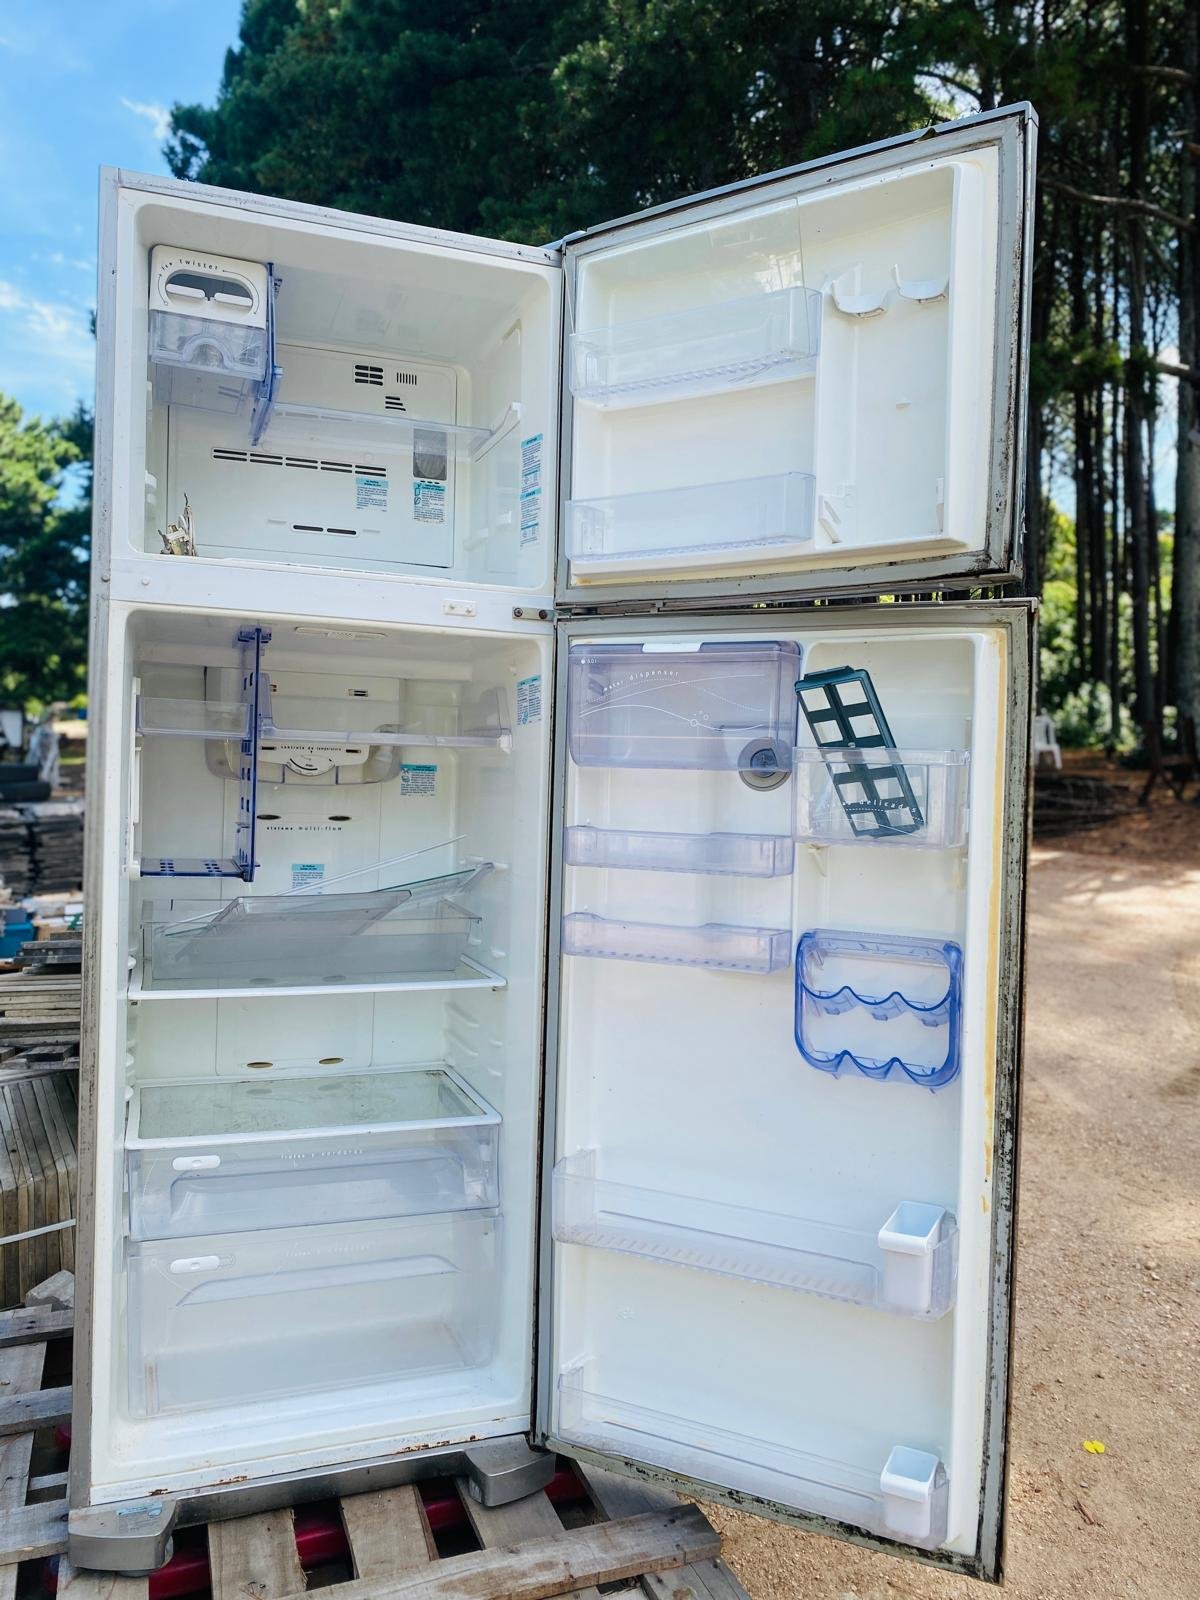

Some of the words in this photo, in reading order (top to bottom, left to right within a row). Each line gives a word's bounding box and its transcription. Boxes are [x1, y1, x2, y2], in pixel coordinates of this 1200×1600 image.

[179, 258, 218, 271] twister
[629, 670, 679, 681] dispenser
[859, 799, 917, 813] delicads
